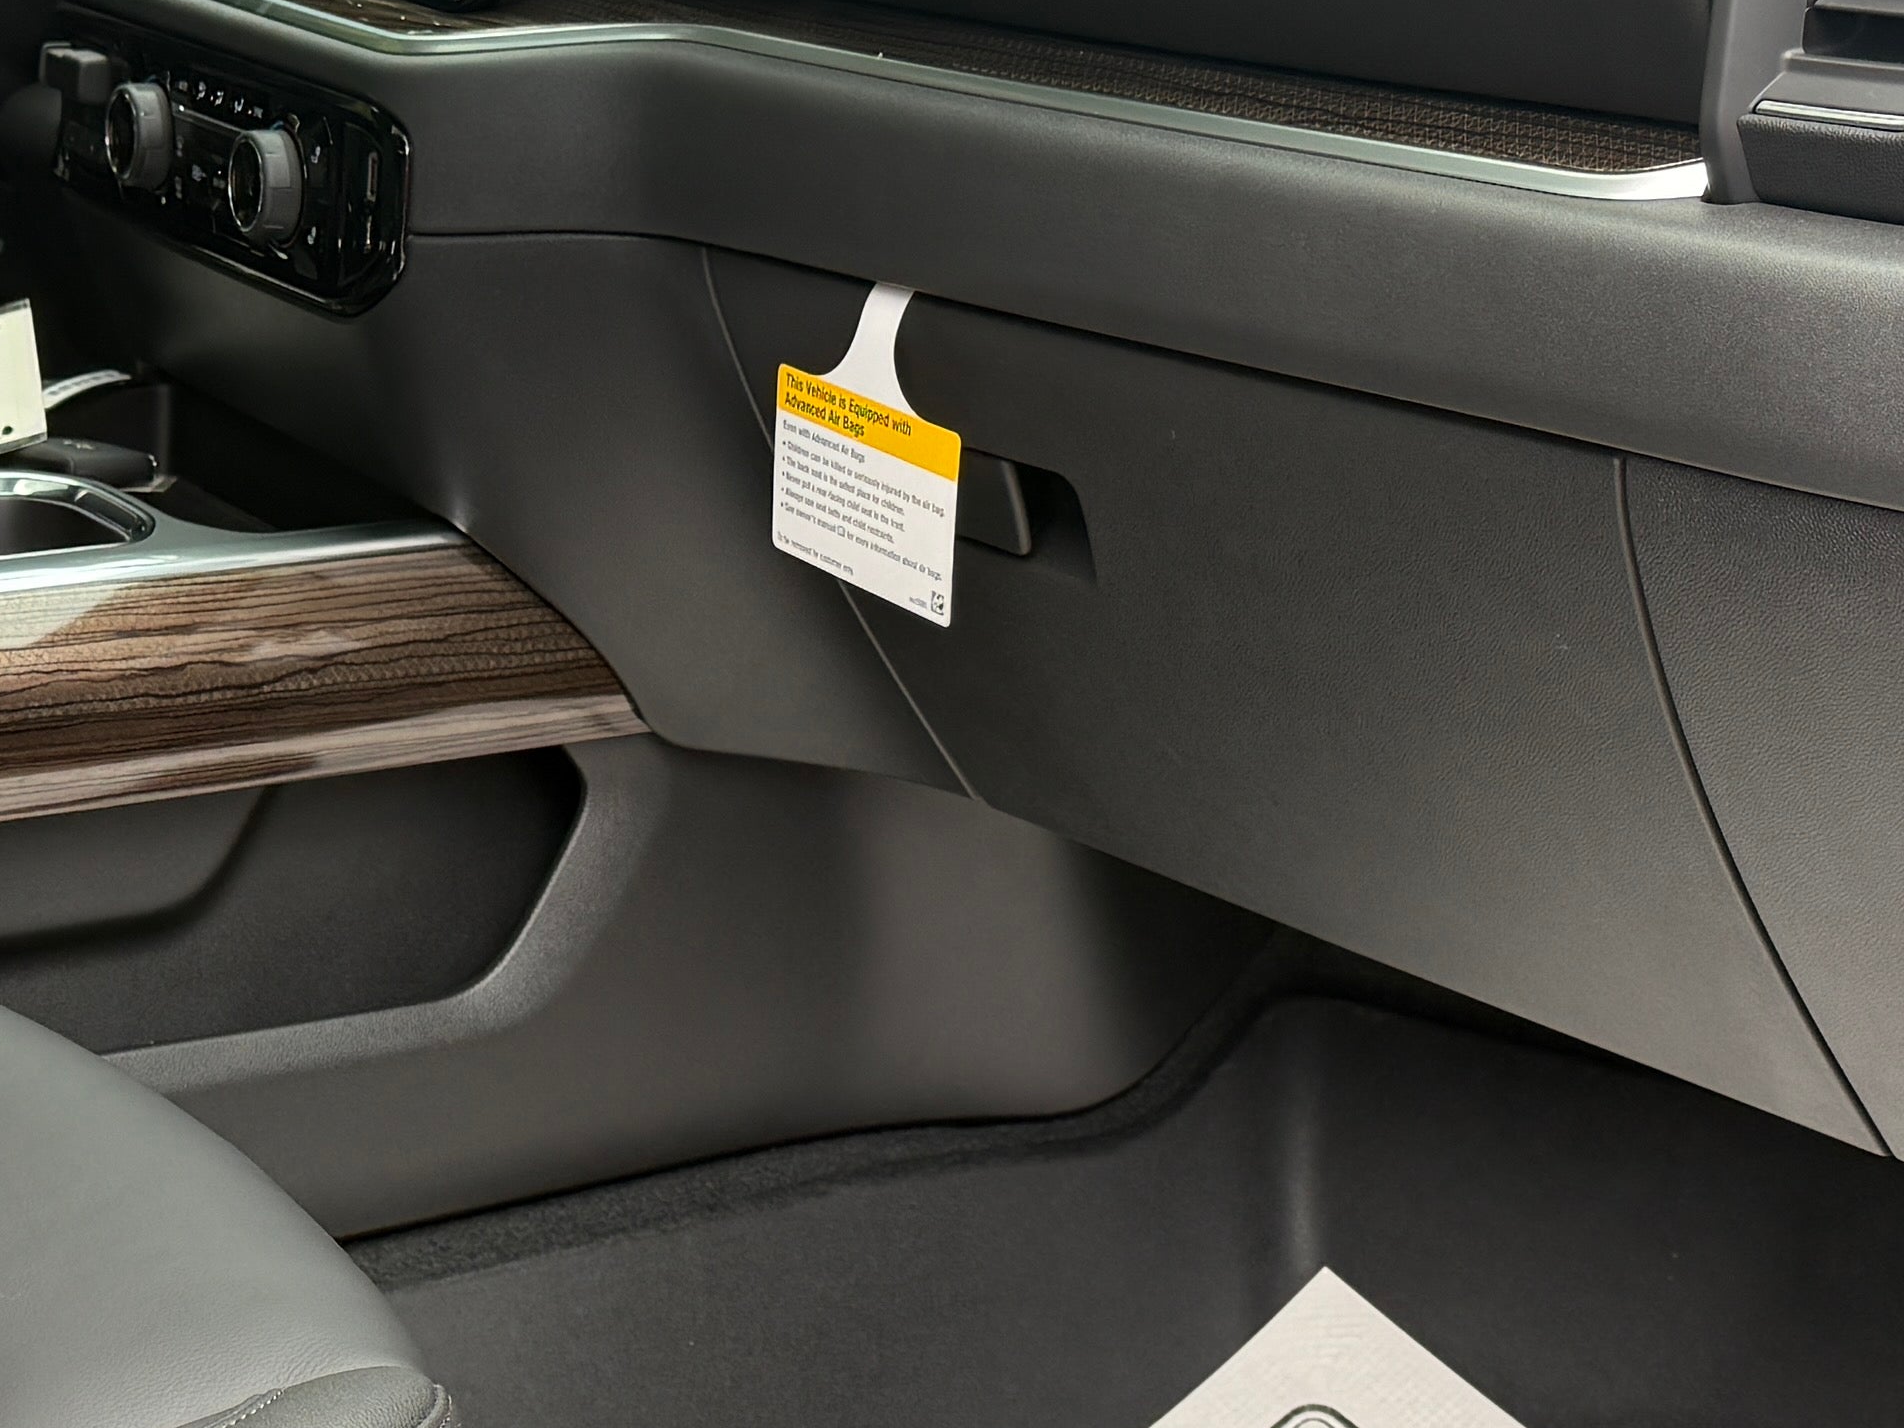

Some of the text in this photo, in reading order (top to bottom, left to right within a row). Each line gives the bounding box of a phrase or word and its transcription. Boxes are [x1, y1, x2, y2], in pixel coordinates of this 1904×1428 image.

[784, 390, 865, 440] Advanced Air Bags
[785, 371, 912, 437] This Vehicle is Equipped with
